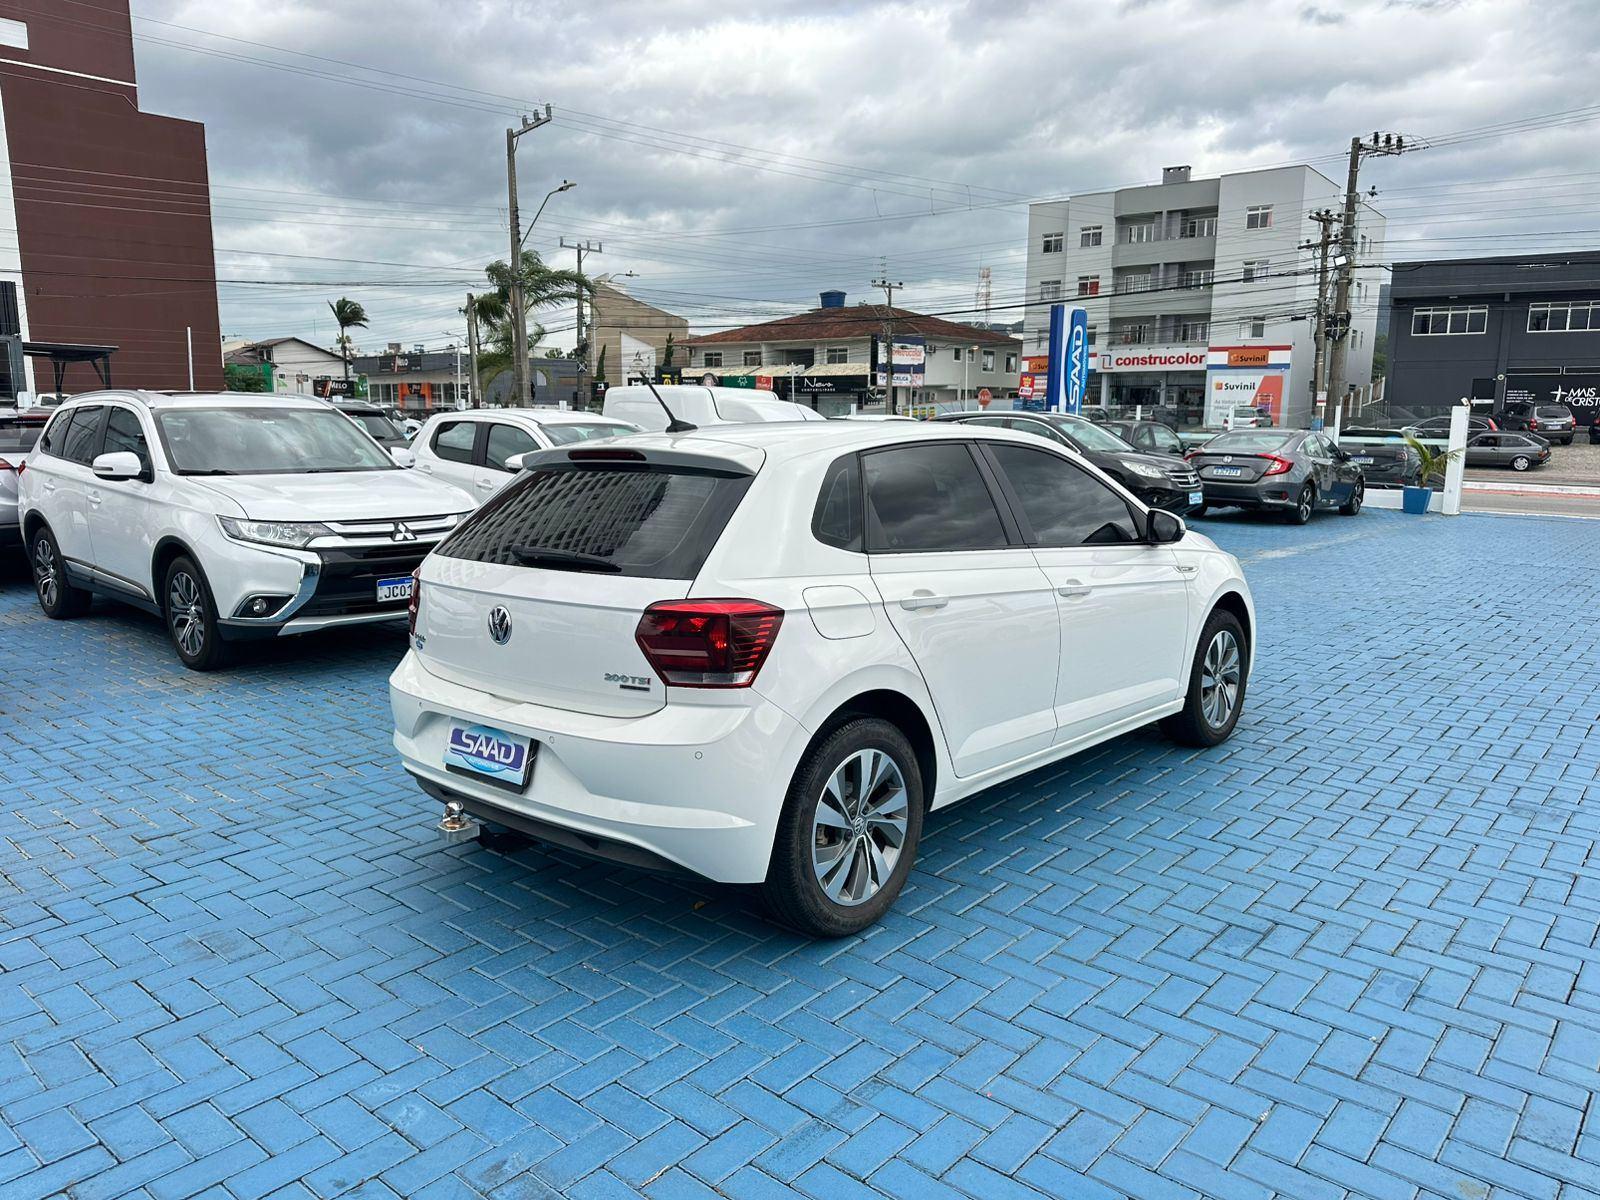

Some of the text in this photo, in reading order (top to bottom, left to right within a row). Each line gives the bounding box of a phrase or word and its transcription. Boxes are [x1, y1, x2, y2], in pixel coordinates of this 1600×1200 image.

[1115, 352, 1206, 367] construcolor
[1239, 354, 1266, 362] Suvinil
[1069, 324, 1083, 415] SAAD
[1224, 382, 1256, 391] Suvinil
[1569, 387, 1597, 398] MAIS
[1571, 397, 1600, 407] CRIST
[450, 730, 516, 764] SAAD
